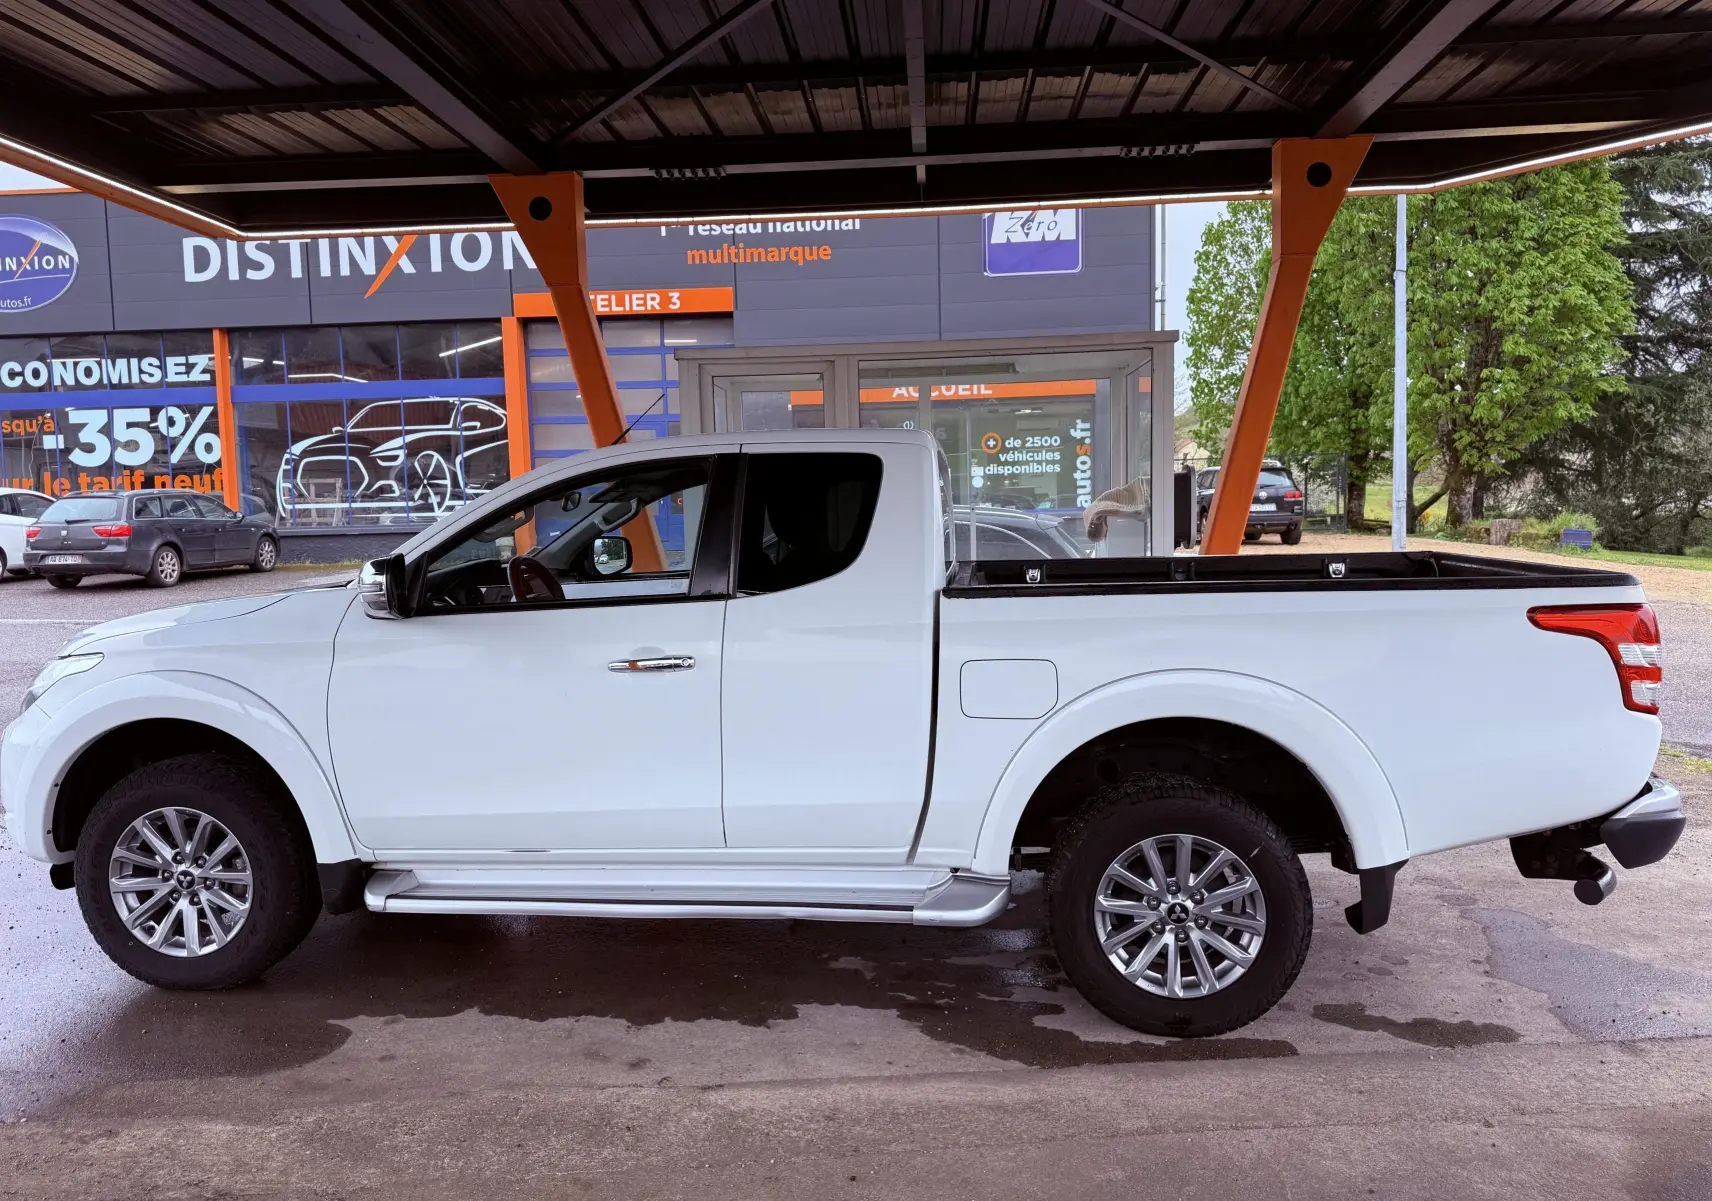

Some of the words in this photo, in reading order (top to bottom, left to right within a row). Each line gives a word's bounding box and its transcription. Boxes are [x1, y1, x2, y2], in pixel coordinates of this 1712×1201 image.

[687, 242, 832, 266] multimarque
[668, 292, 680, 309] 3
[0, 355, 211, 387] CONOMISEZ
[892, 384, 993, 398] AUEIL
[43, 405, 222, 467] -35%
[1005, 437, 1022, 448] de
[1025, 436, 1061, 447] 2500
[999, 449, 1061, 461] véhicules
[1070, 419, 1092, 508] autos.fr
[985, 462, 1061, 476] disponibles
[44, 471, 71, 497] le
[78, 469, 145, 494] tarif
[154, 467, 224, 491] neuf
